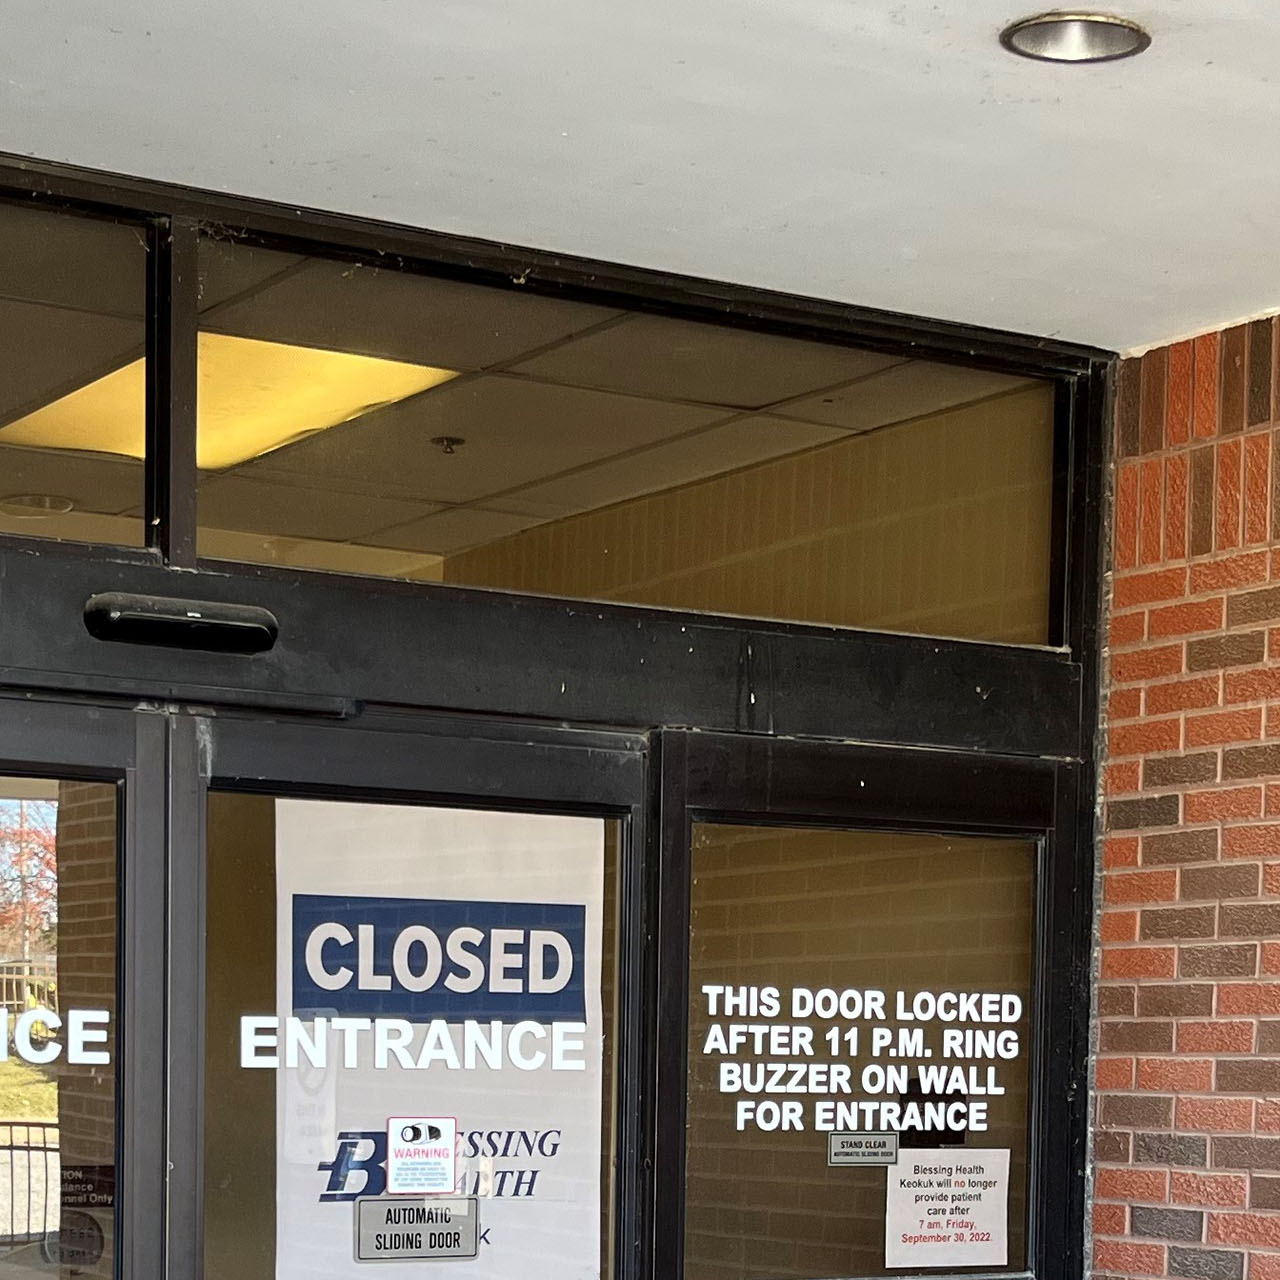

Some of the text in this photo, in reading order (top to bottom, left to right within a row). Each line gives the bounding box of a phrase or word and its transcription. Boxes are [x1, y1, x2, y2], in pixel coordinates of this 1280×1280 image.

[304, 921, 573, 995] CLOSED
[701, 985, 1022, 1023] THIS DOOR LOCKED
[240, 1015, 587, 1072] ENTRANCE
[703, 1024, 1019, 1060] AFTER 11 P.M. RING
[719, 1062, 1005, 1096] BUZZER ON WALL
[736, 1101, 988, 1132] FOR ENTRANCE
[840, 1140, 887, 1149] STAND CLEAR
[393, 1147, 450, 1159] WARNING
[913, 1165, 984, 1177] Blessing Health
[900, 1179, 934, 1188] Keokuk
[937, 1179, 952, 1188] will
[968, 1179, 997, 1190] longer
[89, 1193, 113, 1204] Only
[915, 1193, 981, 1204] provide patient
[385, 1207, 451, 1225] AUTOMATIC
[927, 1206, 970, 1216] care after
[919, 1220, 925, 1229] 7
[375, 1233, 422, 1251] SLIDING
[429, 1231, 461, 1249] DOOR
[901, 1233, 951, 1244] September
